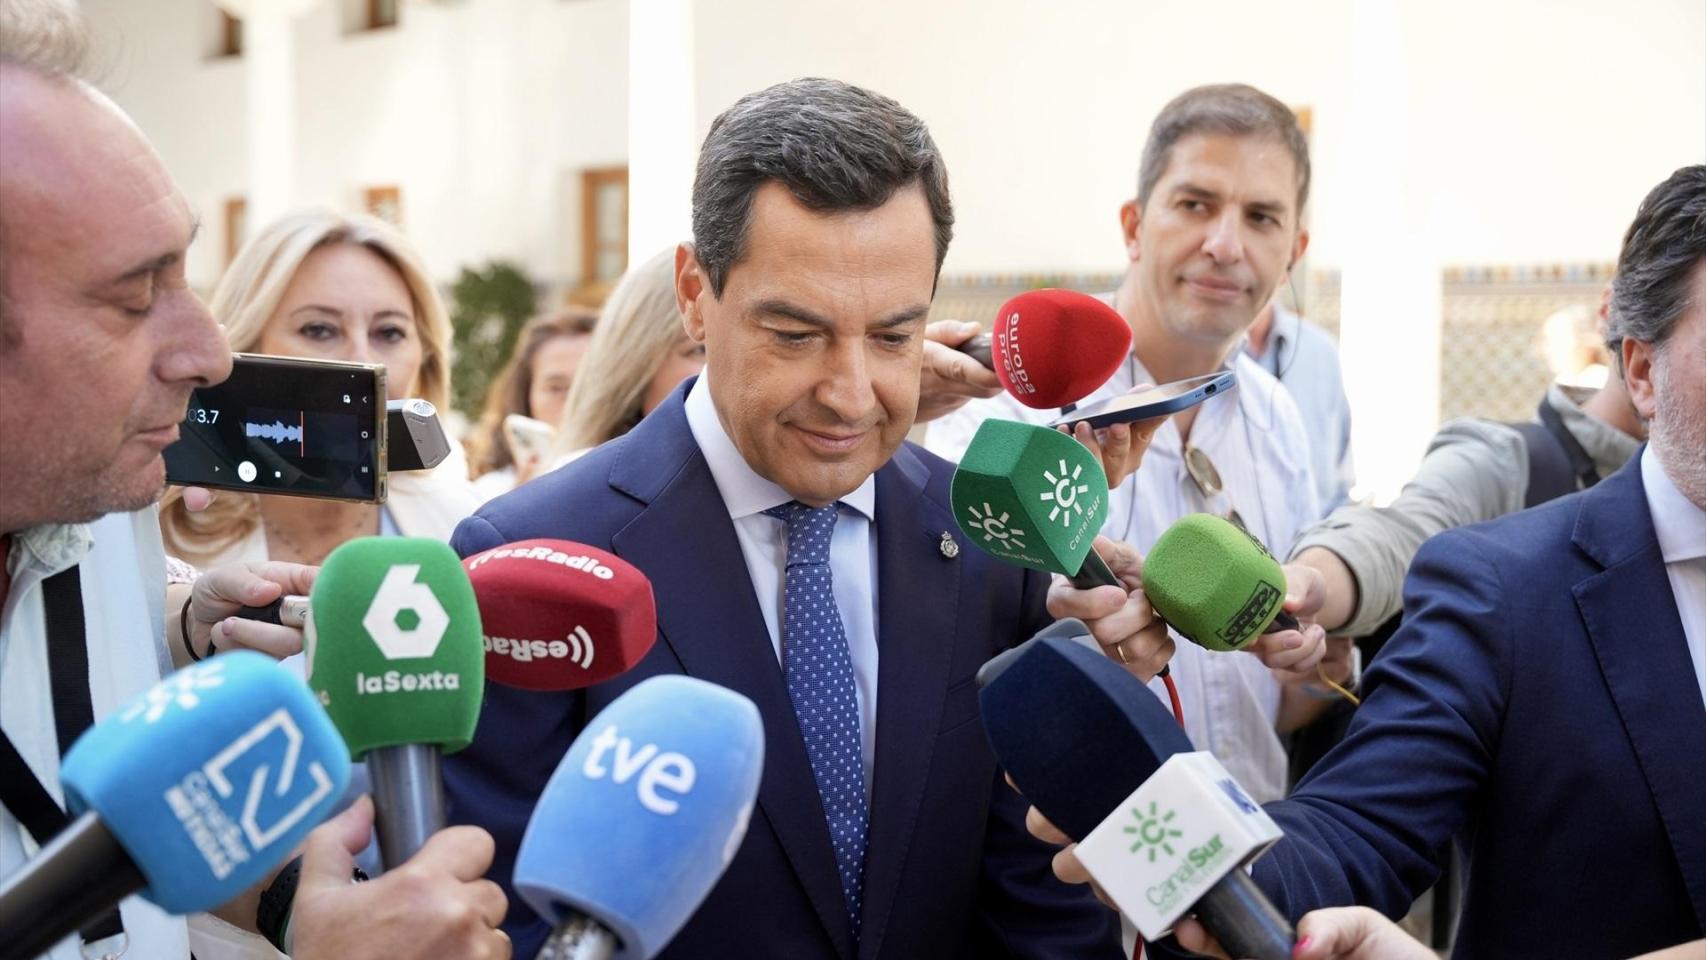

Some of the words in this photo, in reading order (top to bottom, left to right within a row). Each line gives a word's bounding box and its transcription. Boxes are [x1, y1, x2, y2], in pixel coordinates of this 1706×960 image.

[1009, 312, 1036, 394] europa
[1069, 494, 1102, 551] CanalSur
[488, 545, 614, 581] esRadio
[362, 563, 451, 660] 6
[483, 634, 570, 663] esRa
[357, 669, 460, 695] laSexta
[582, 724, 697, 816] tve
[1145, 831, 1225, 906] CanalSur
